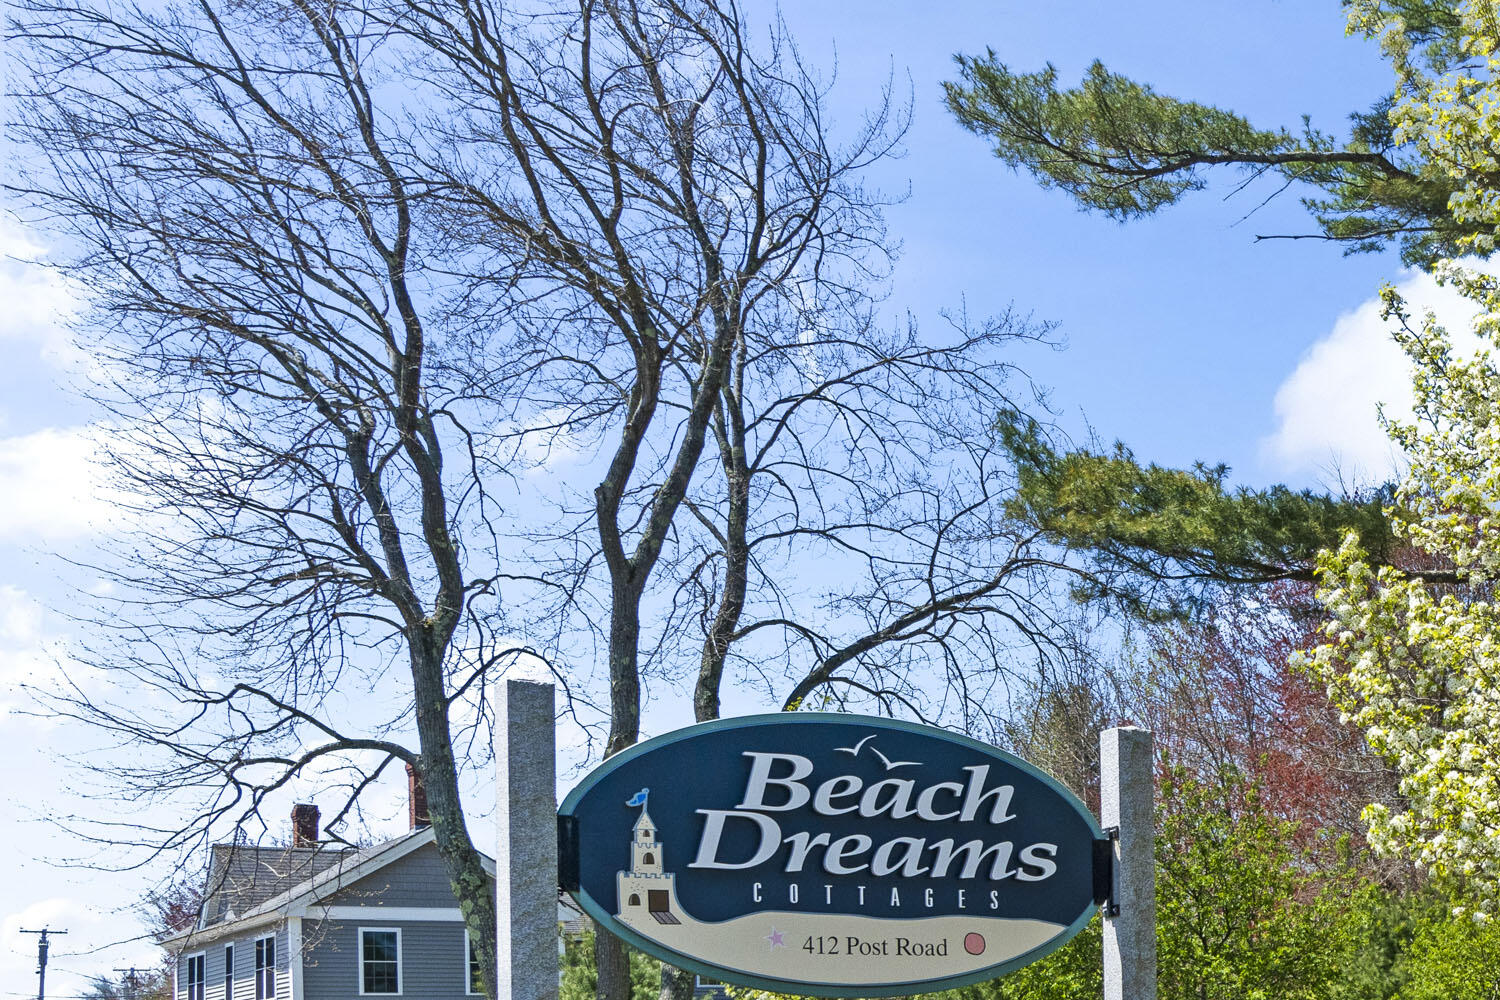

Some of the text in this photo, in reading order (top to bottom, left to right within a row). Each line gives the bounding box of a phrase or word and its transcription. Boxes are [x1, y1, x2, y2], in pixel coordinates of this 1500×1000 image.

[734, 751, 1017, 824] Beach
[687, 808, 1058, 881] Dreams
[753, 882, 999, 910] COTTAGES
[803, 935, 948, 957] 412 Post Road
